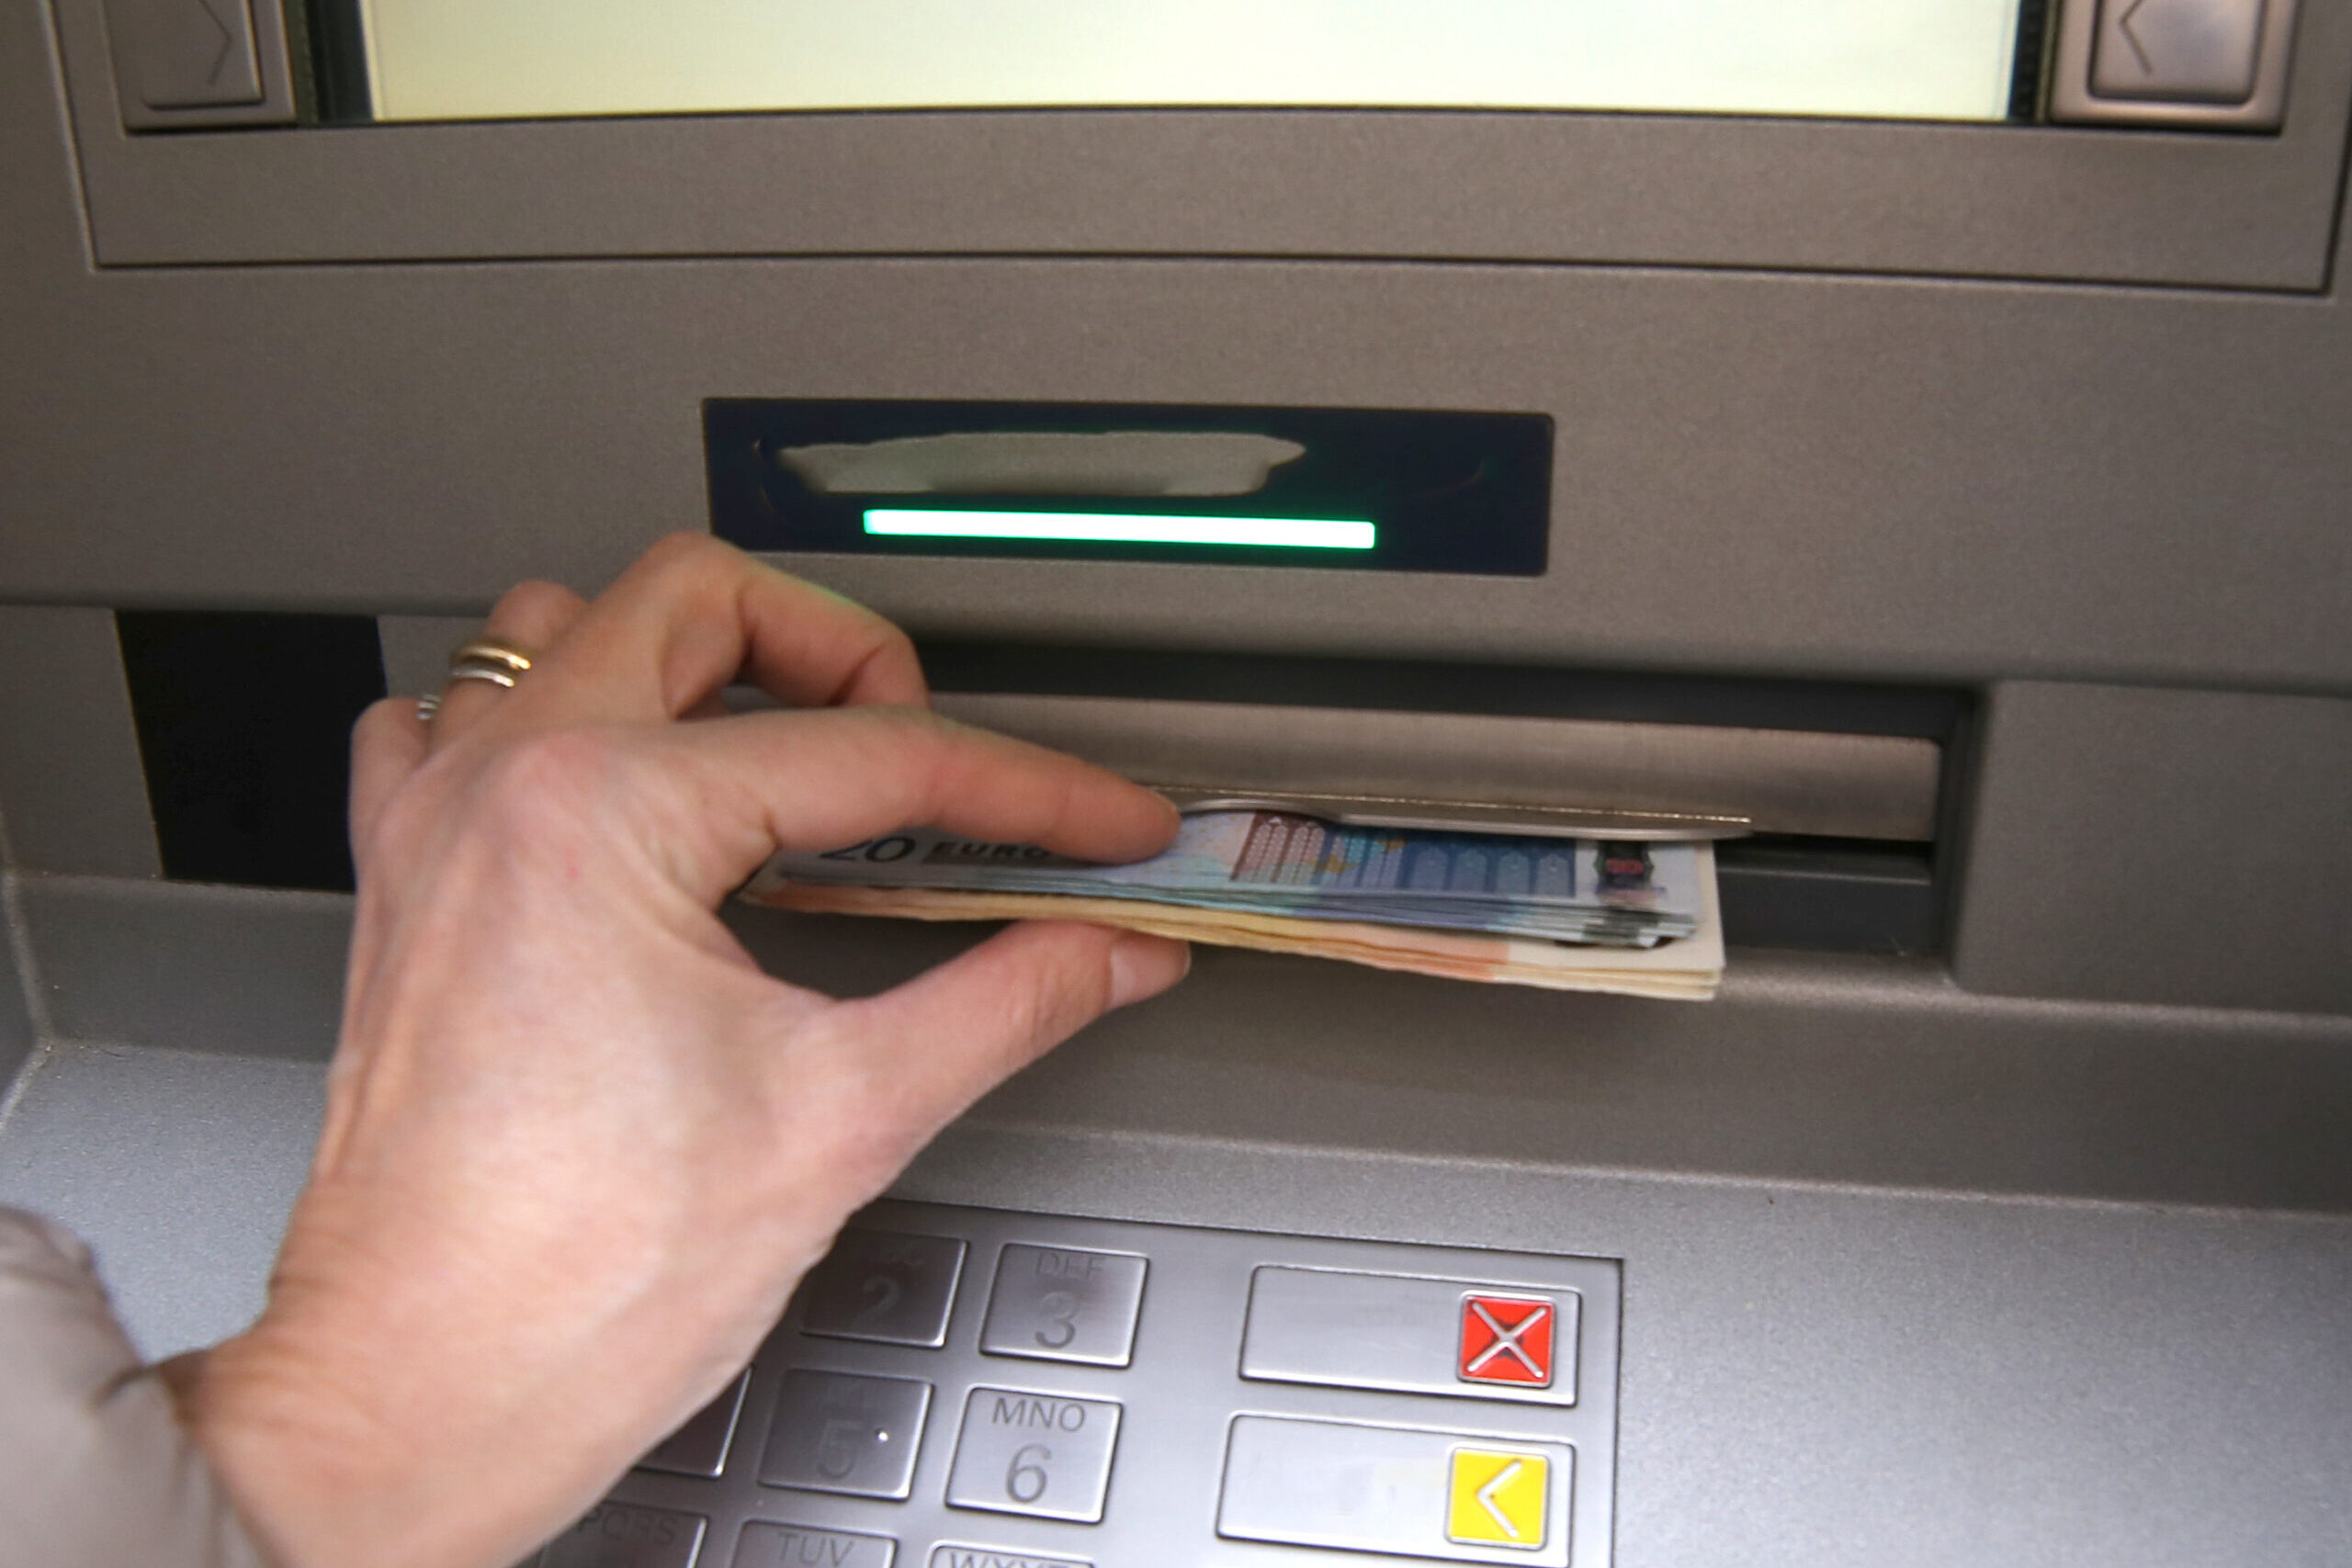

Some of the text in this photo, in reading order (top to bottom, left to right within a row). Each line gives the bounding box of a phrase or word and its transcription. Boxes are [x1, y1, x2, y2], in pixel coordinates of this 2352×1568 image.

[818, 837, 1053, 863] 20 EURO
[1035, 1252, 1105, 1280] DEF
[1035, 1290, 1082, 1349] 3
[991, 1396, 1086, 1432] MNO
[1005, 1442, 1052, 1504] 6
[779, 1531, 854, 1568] TUV
